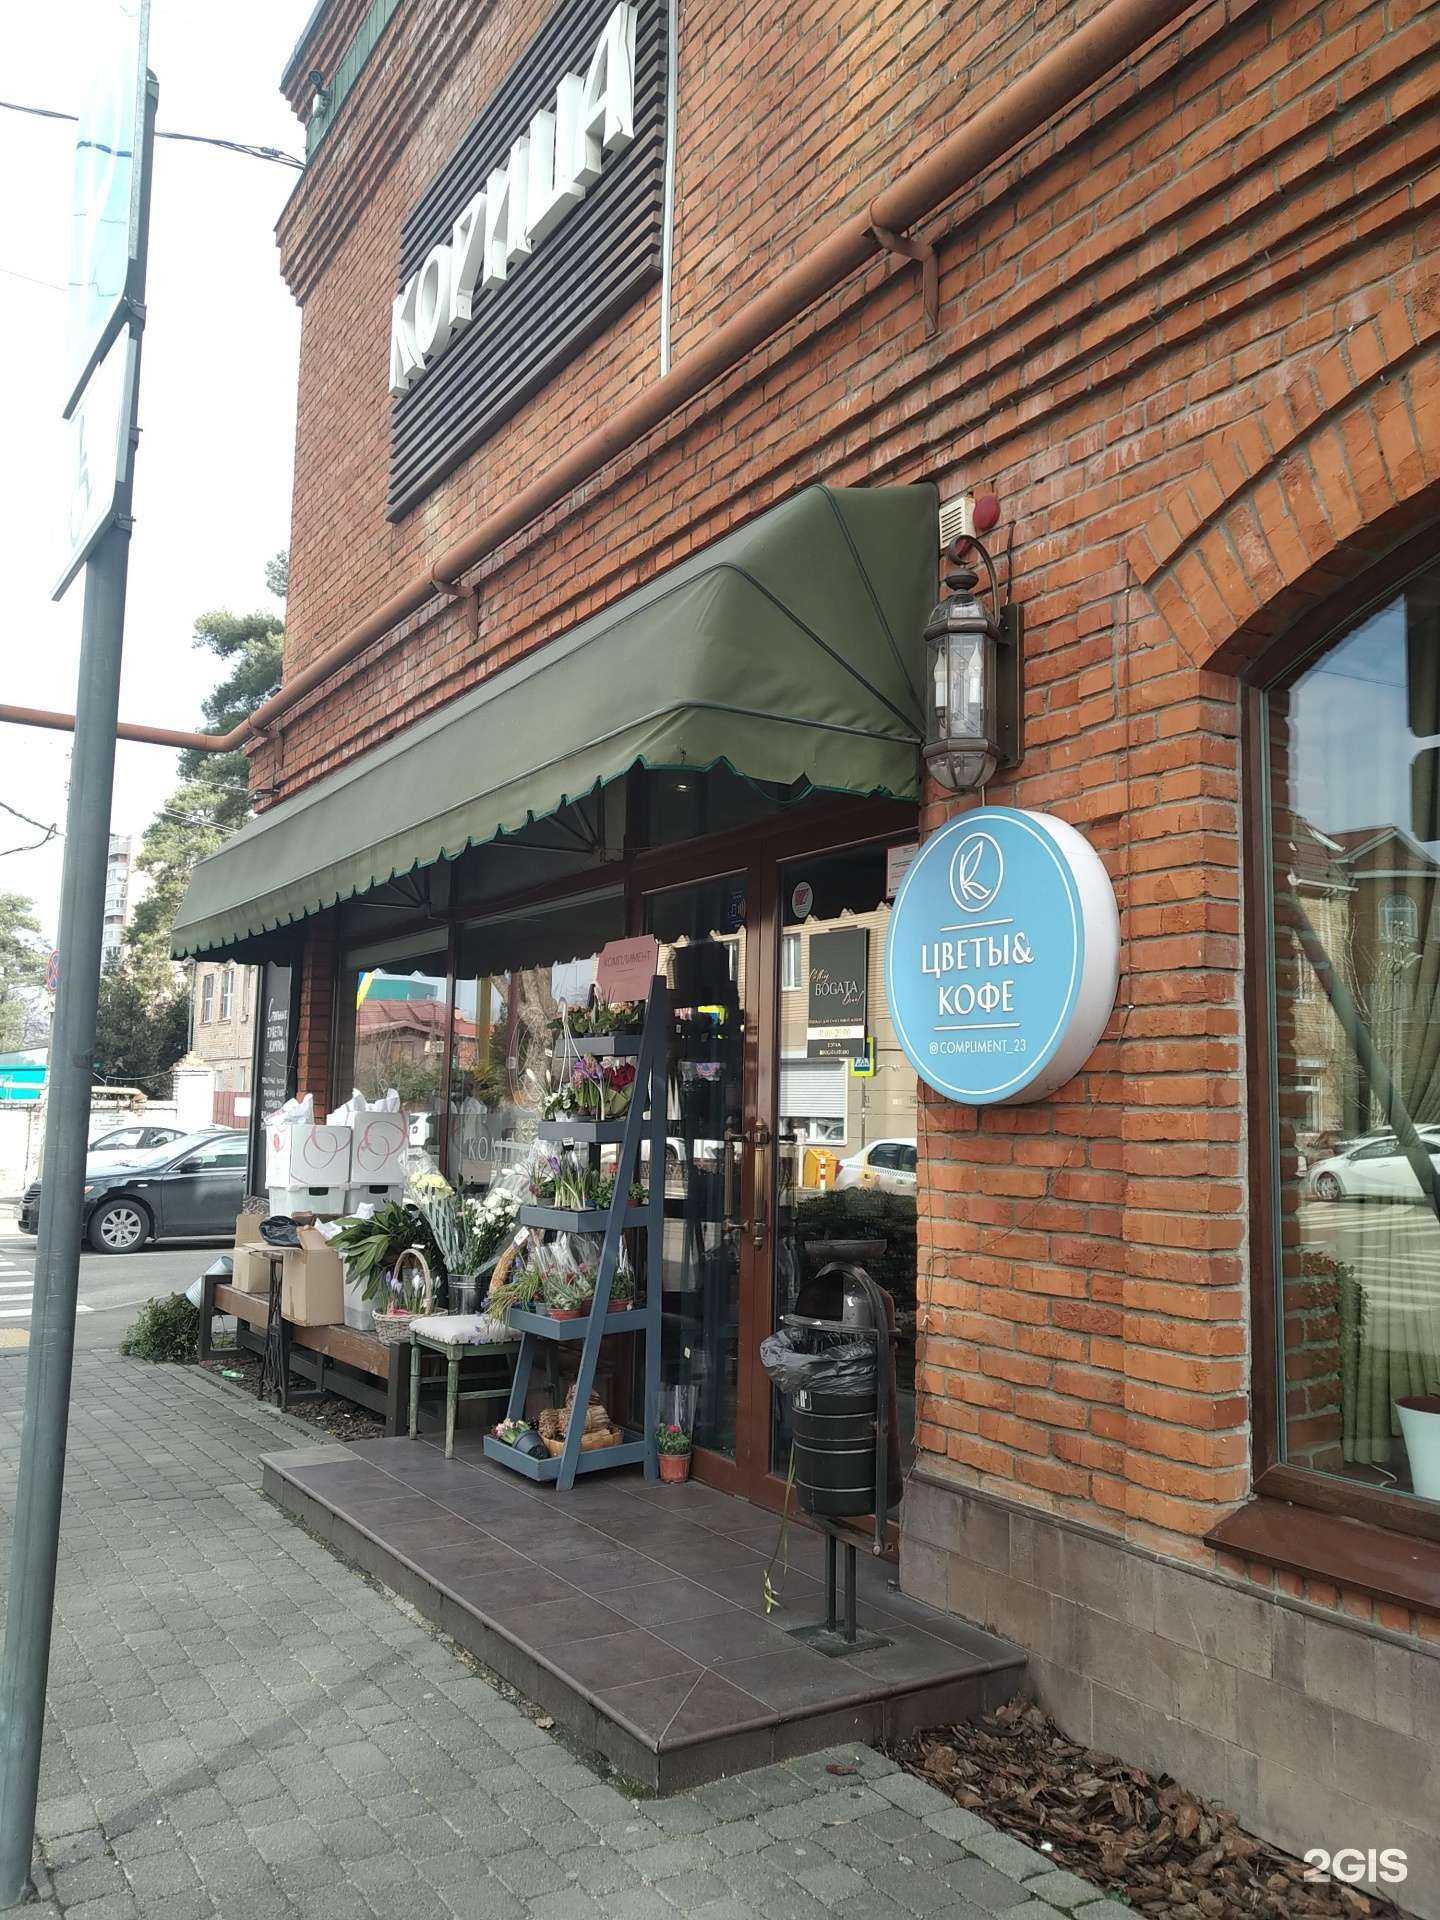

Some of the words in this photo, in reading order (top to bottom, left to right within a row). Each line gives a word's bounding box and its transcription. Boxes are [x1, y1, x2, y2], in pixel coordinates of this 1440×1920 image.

[920, 931, 1035, 979] ЦВЕТЫ&
[815, 981, 858, 996] BOGATA
[938, 980, 1015, 1016] КОФЕ
